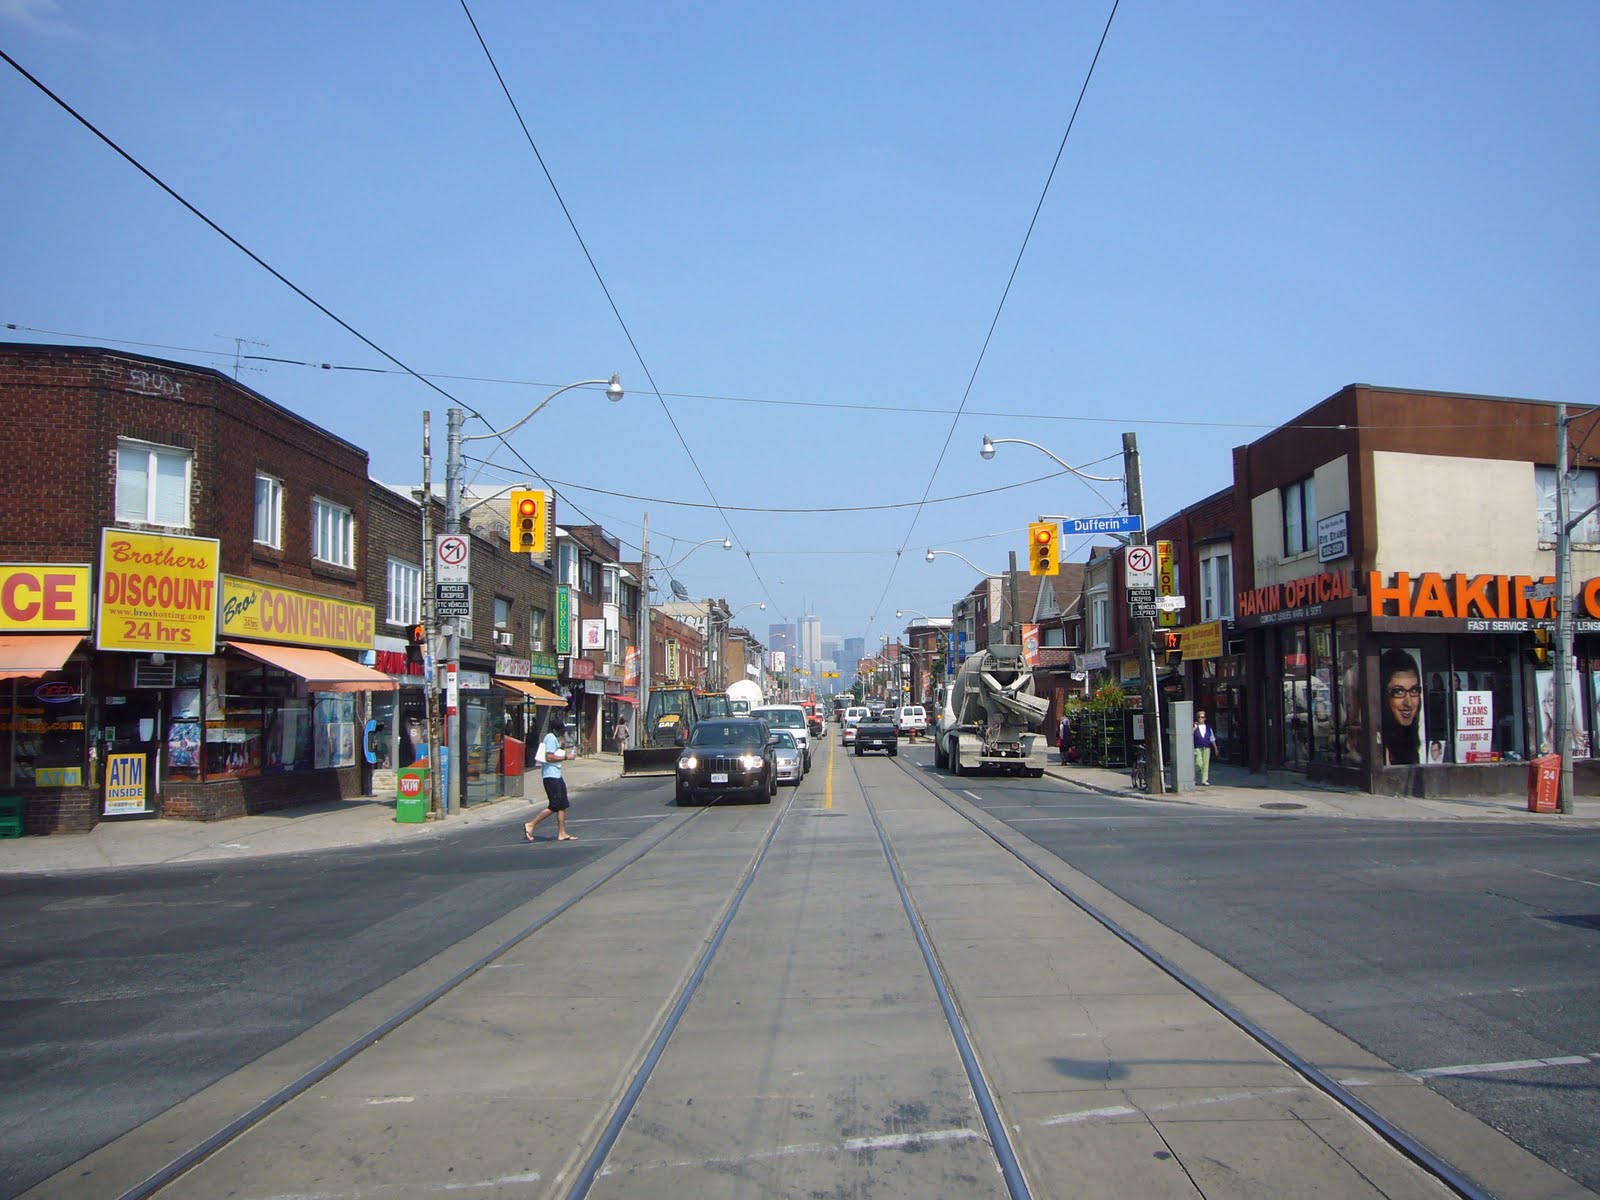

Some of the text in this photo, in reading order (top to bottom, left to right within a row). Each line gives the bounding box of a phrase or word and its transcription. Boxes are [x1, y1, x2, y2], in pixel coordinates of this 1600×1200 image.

[1074, 518, 1120, 531] Dufferin
[1319, 529, 1346, 545] EYE EXAMS
[111, 541, 208, 570] Brothers
[104, 571, 214, 611] DISCOUNT
[1161, 557, 1172, 621] FLORT
[1238, 568, 1354, 617] HAKIM OPTICAL
[1369, 571, 1557, 619] HAKIM
[1, 572, 76, 622] CE
[109, 608, 206, 623] www.broshosting.com
[224, 592, 257, 625] Bros
[261, 590, 372, 644] CONVENIENCE
[123, 620, 192, 642] 24 hrs
[1467, 621, 1490, 631] FAST
[1492, 621, 1528, 631] SERVICE
[38, 685, 80, 696] OPEN
[1468, 695, 1482, 705] EYE
[1462, 706, 1488, 715] EXAMS
[1466, 717, 1484, 726] HERE
[40, 771, 77, 785] ATM
[109, 758, 142, 786] ATM
[1543, 770, 1555, 780] 24
[108, 787, 143, 798] INSIDE
[401, 779, 420, 792] NOW
